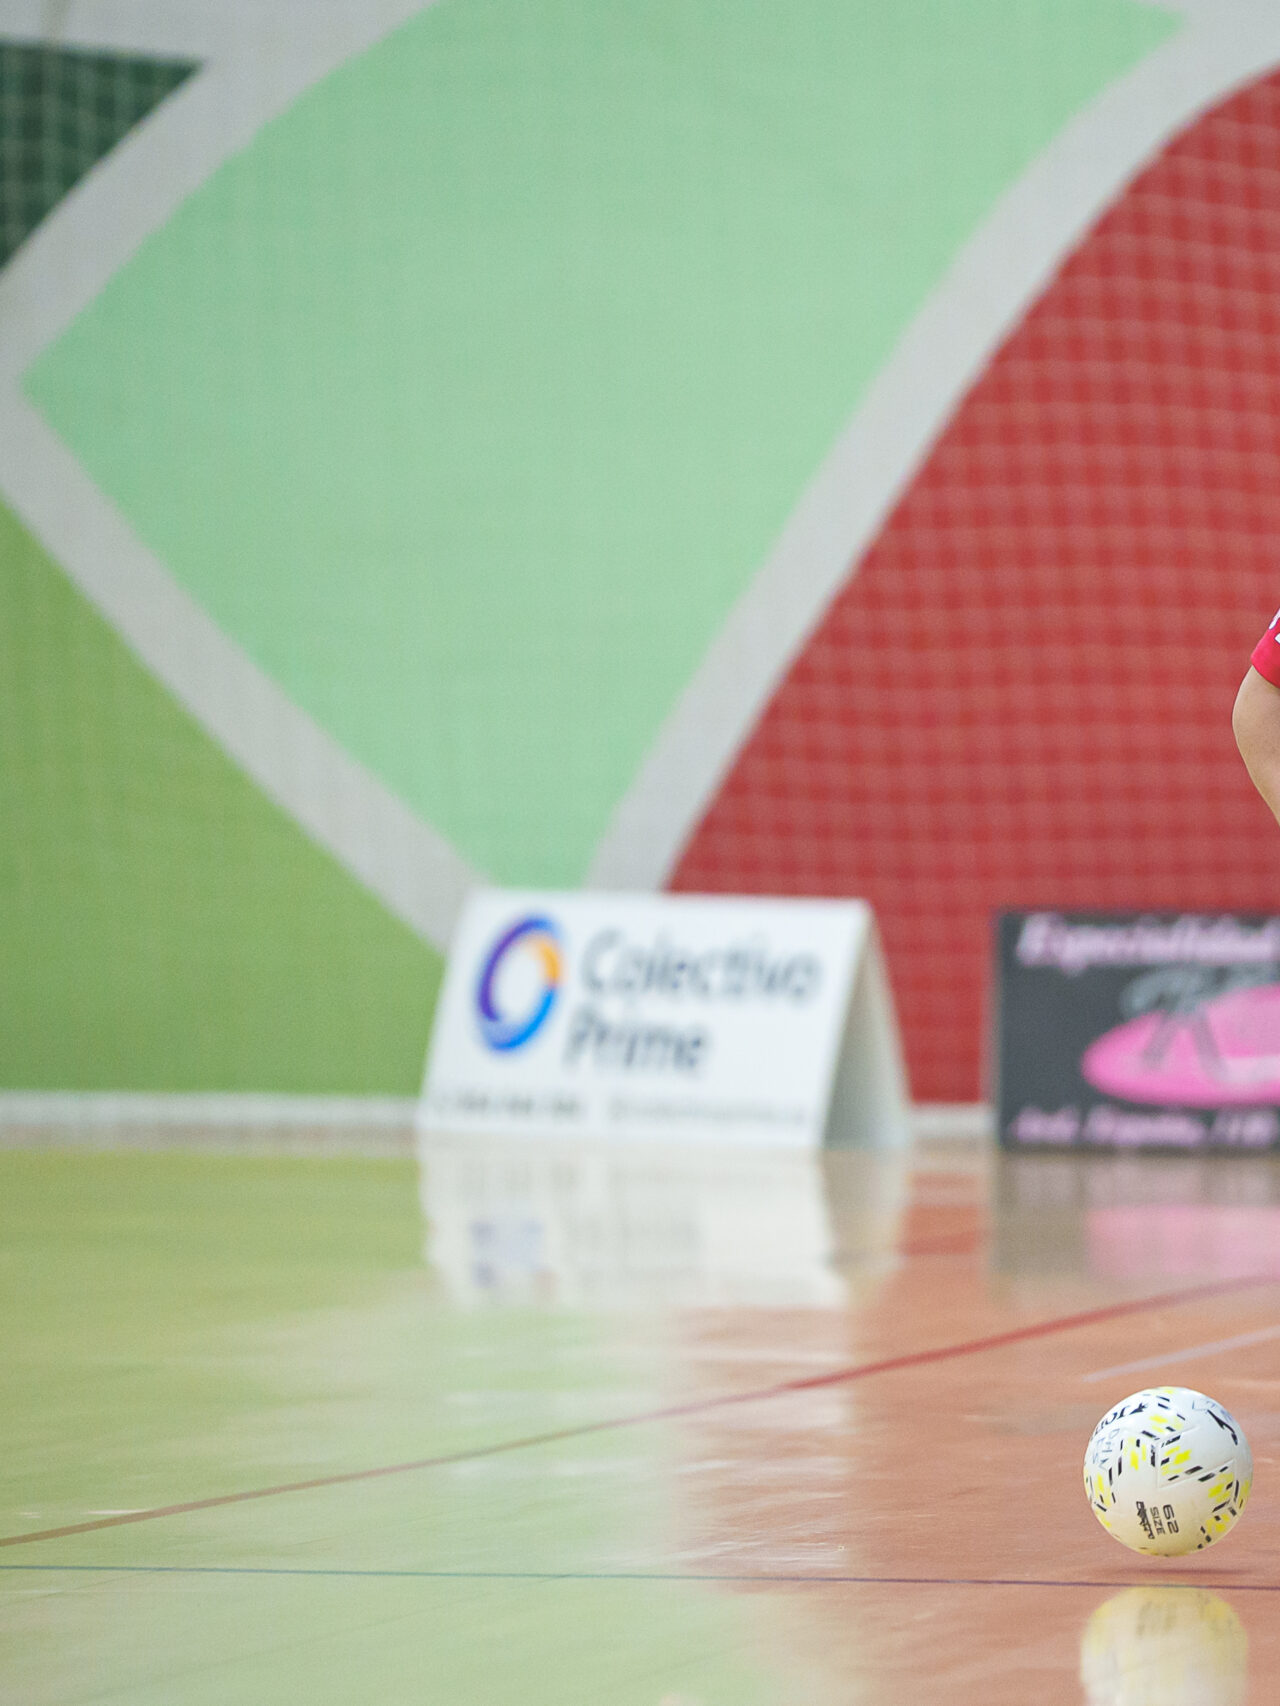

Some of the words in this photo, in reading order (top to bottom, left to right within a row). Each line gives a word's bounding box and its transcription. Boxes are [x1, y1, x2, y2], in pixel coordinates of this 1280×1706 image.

[581, 927, 822, 1004] Colectivo
[564, 1004, 710, 1070] Prime
[1150, 1507, 1166, 1535] SIZE
[1163, 1505, 1179, 1534] 62
